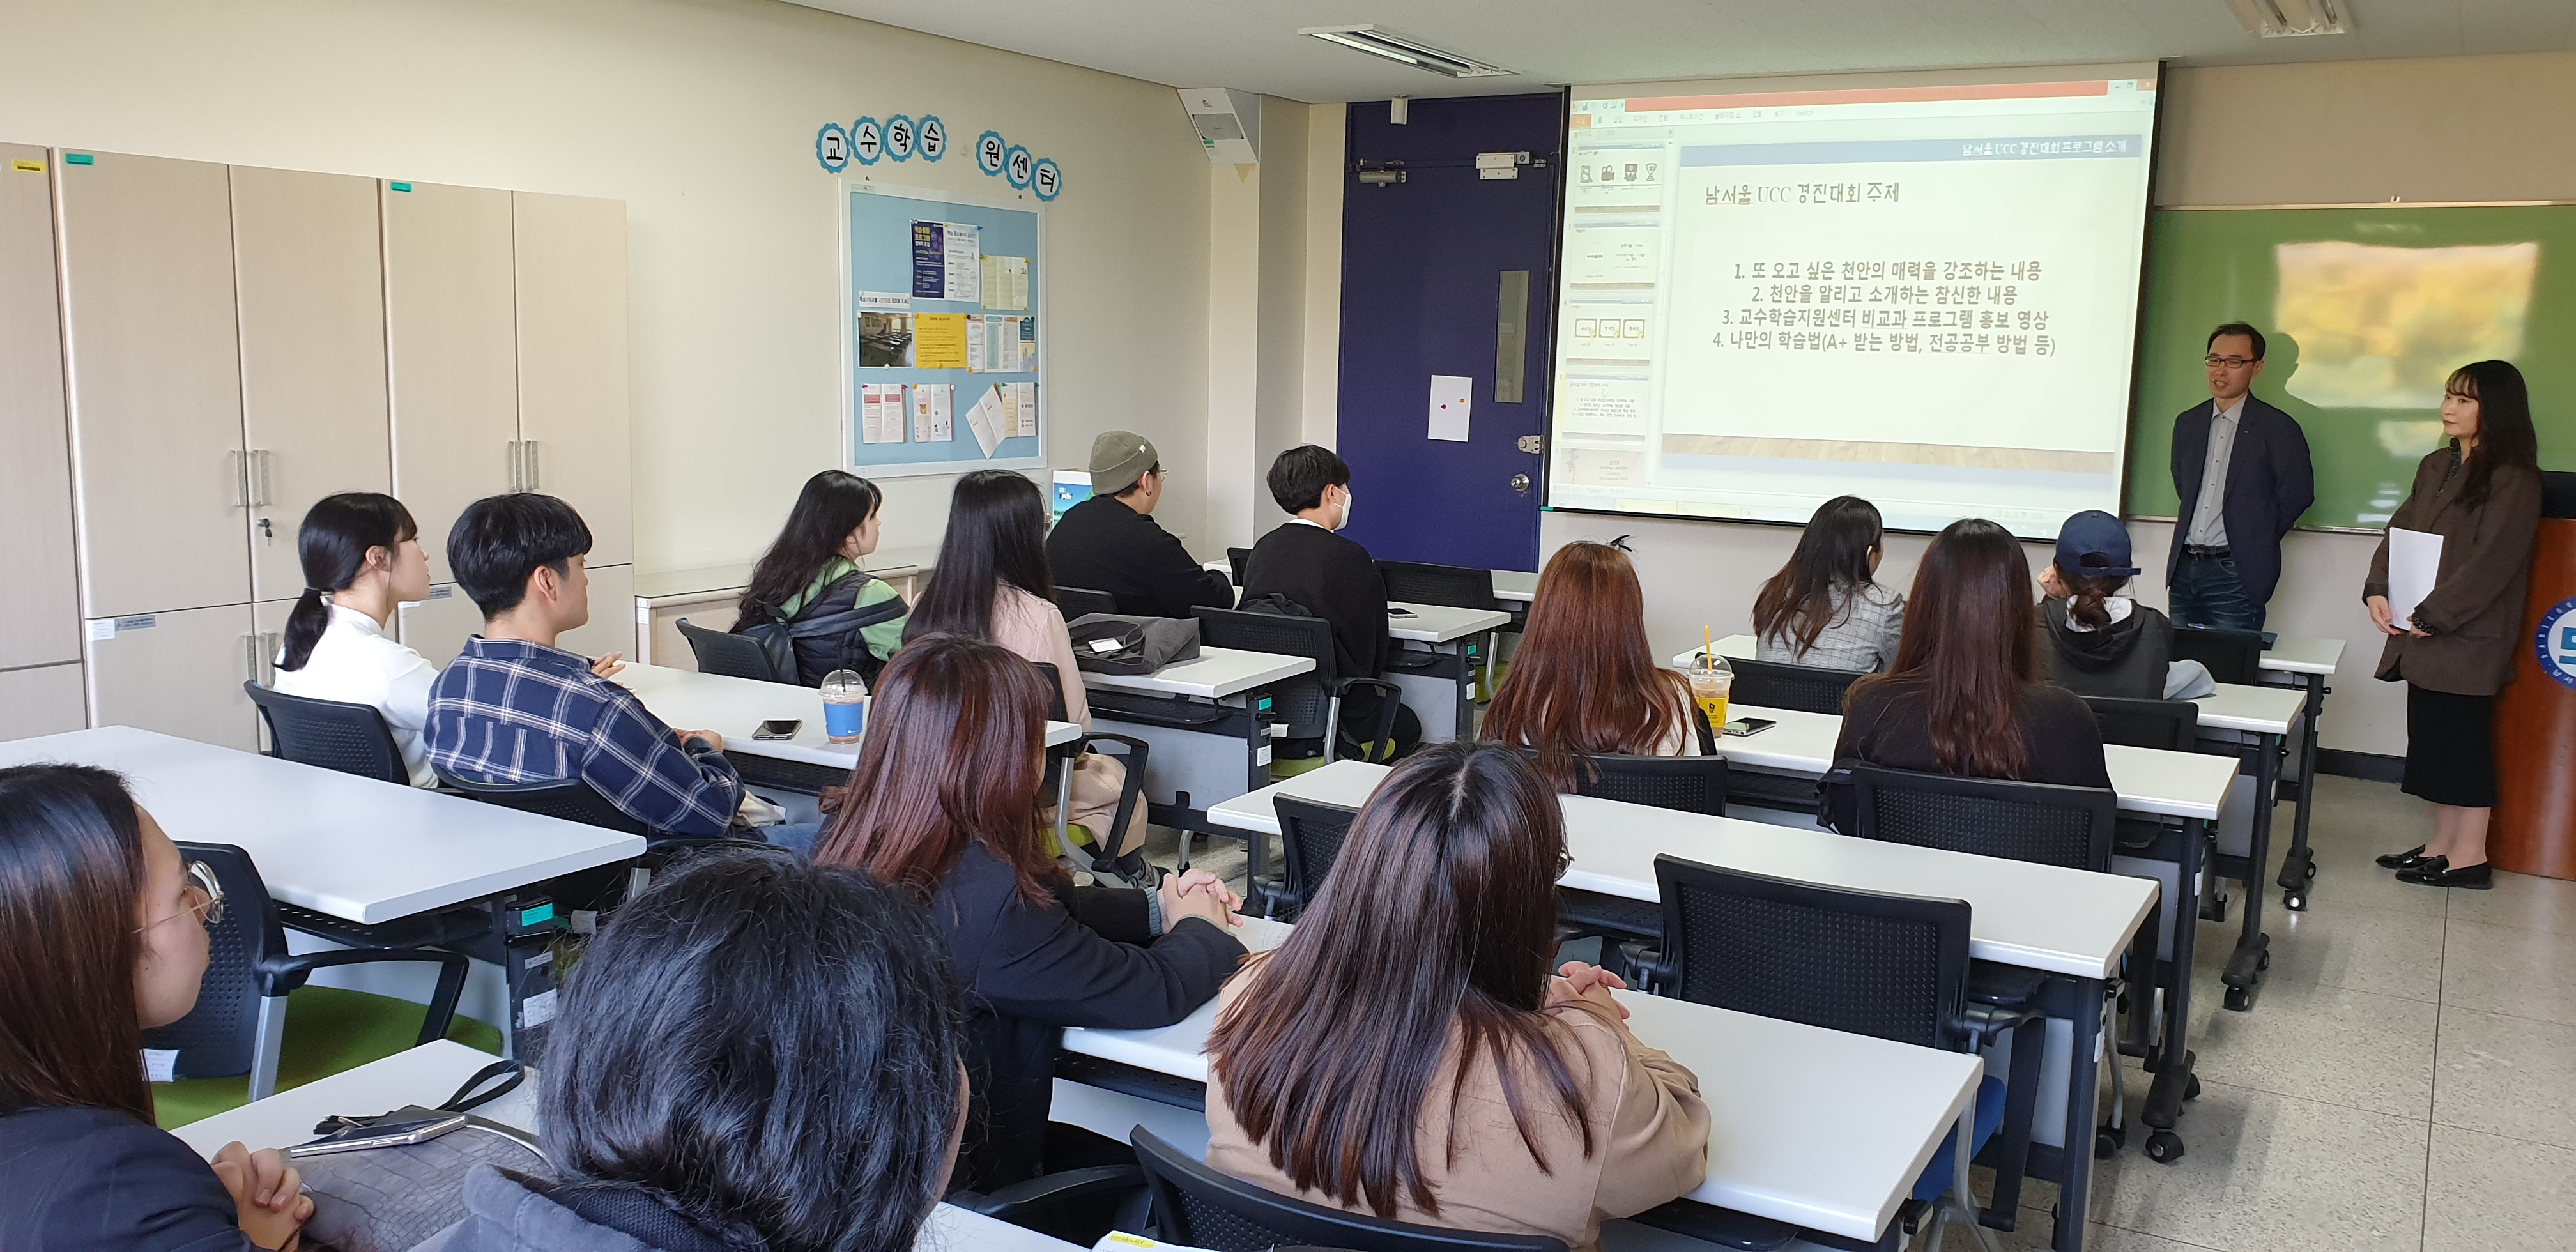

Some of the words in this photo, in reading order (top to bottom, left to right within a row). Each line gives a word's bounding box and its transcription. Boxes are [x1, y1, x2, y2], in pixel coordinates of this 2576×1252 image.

[826, 123, 940, 161] 교수학습
[984, 140, 1056, 193] 원센터
[1963, 142, 1993, 156] 남서울
[1995, 143, 2017, 155] UCC
[2105, 140, 2127, 153] 소개
[1706, 184, 1752, 204] 남서울
[1758, 186, 1791, 202] UCC
[1798, 183, 1860, 204] 경진대회
[1867, 182, 1899, 202] 주제
[1734, 263, 1745, 279] 1.
[1752, 263, 1766, 279] 또
[1772, 262, 1800, 279] 오고
[1807, 261, 1835, 280] 싶은
[1841, 261, 1885, 281] 천안의
[1892, 261, 1936, 281] 매력을
[1943, 261, 2004, 281] 강조하는
[2011, 261, 2043, 281] 내용
[1752, 286, 1763, 302] 2.
[1770, 284, 1813, 303] 천안을
[1819, 284, 1862, 304] 알리고
[1868, 285, 1929, 305] 소개하는
[1935, 285, 1981, 305] 참신한
[1987, 285, 2018, 305] 내용
[1722, 310, 1733, 324] 3.
[1739, 307, 1856, 328] 교수학습지원센터
[1862, 309, 1907, 329] 비교과
[1912, 310, 1973, 329] 프로그램
[1979, 310, 2010, 330] 홍보
[2017, 310, 2049, 330] 영상
[1713, 332, 1724, 347] 4.
[1730, 330, 1772, 349] 나만의
[1778, 331, 1847, 353] 학습법(A+
[1853, 332, 1882, 351] 받는
[1889, 333, 1922, 354] 방법,
[1929, 333, 1990, 353] 전공공부
[1997, 334, 2027, 355] 방법
[2034, 335, 2055, 358] 등)
